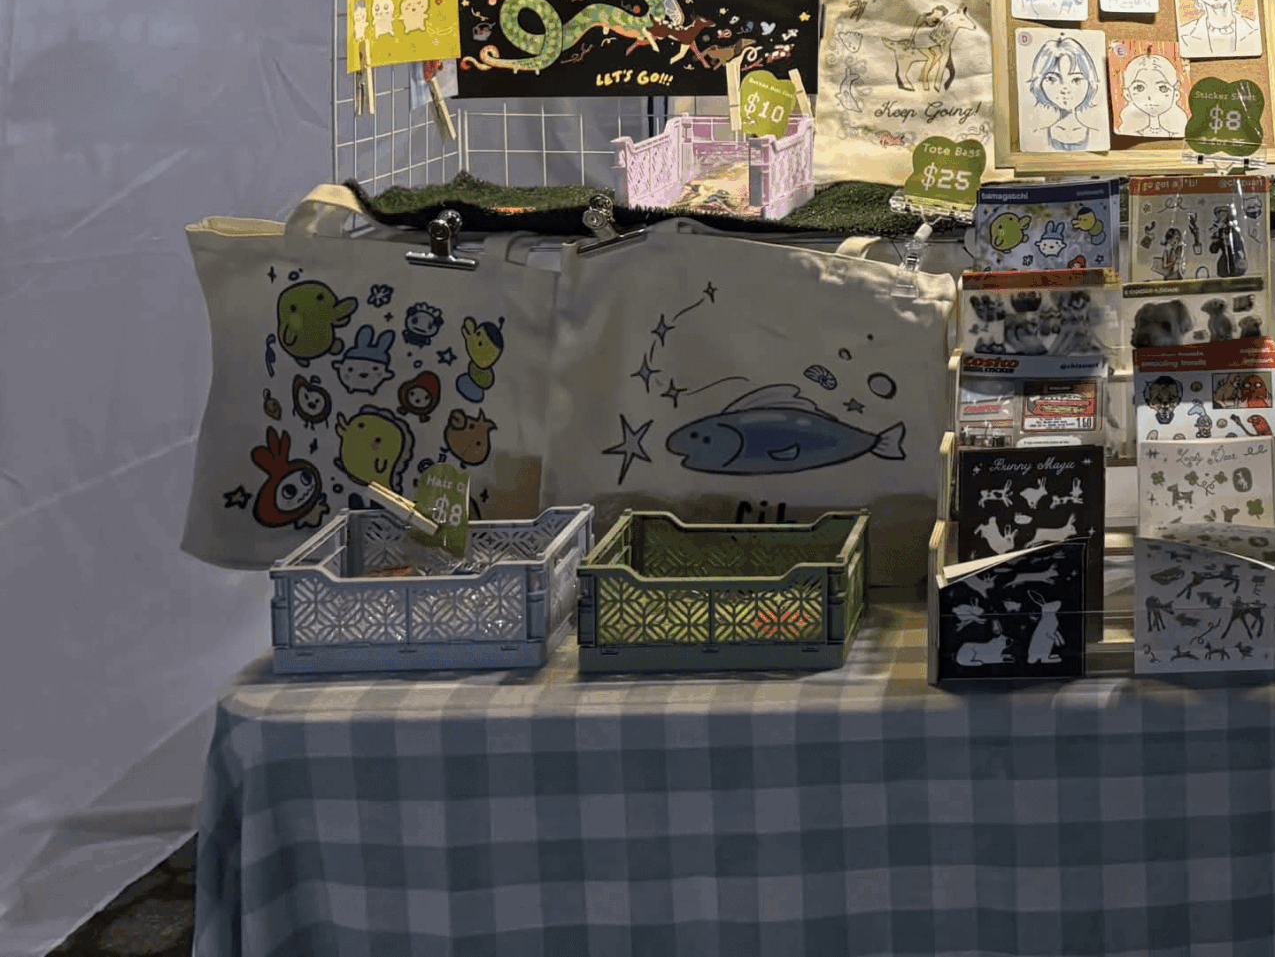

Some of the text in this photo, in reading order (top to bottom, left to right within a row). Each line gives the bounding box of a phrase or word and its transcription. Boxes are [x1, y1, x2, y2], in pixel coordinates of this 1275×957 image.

[595, 69, 674, 86] LET'S GO!!!
[743, 91, 785, 123] $10
[1194, 90, 1228, 100] Sticker
[874, 100, 982, 125] Keep Going!
[1209, 103, 1241, 135] $8
[922, 142, 981, 158] Tote Bags
[920, 161, 973, 191] $25
[432, 493, 463, 526] $8
